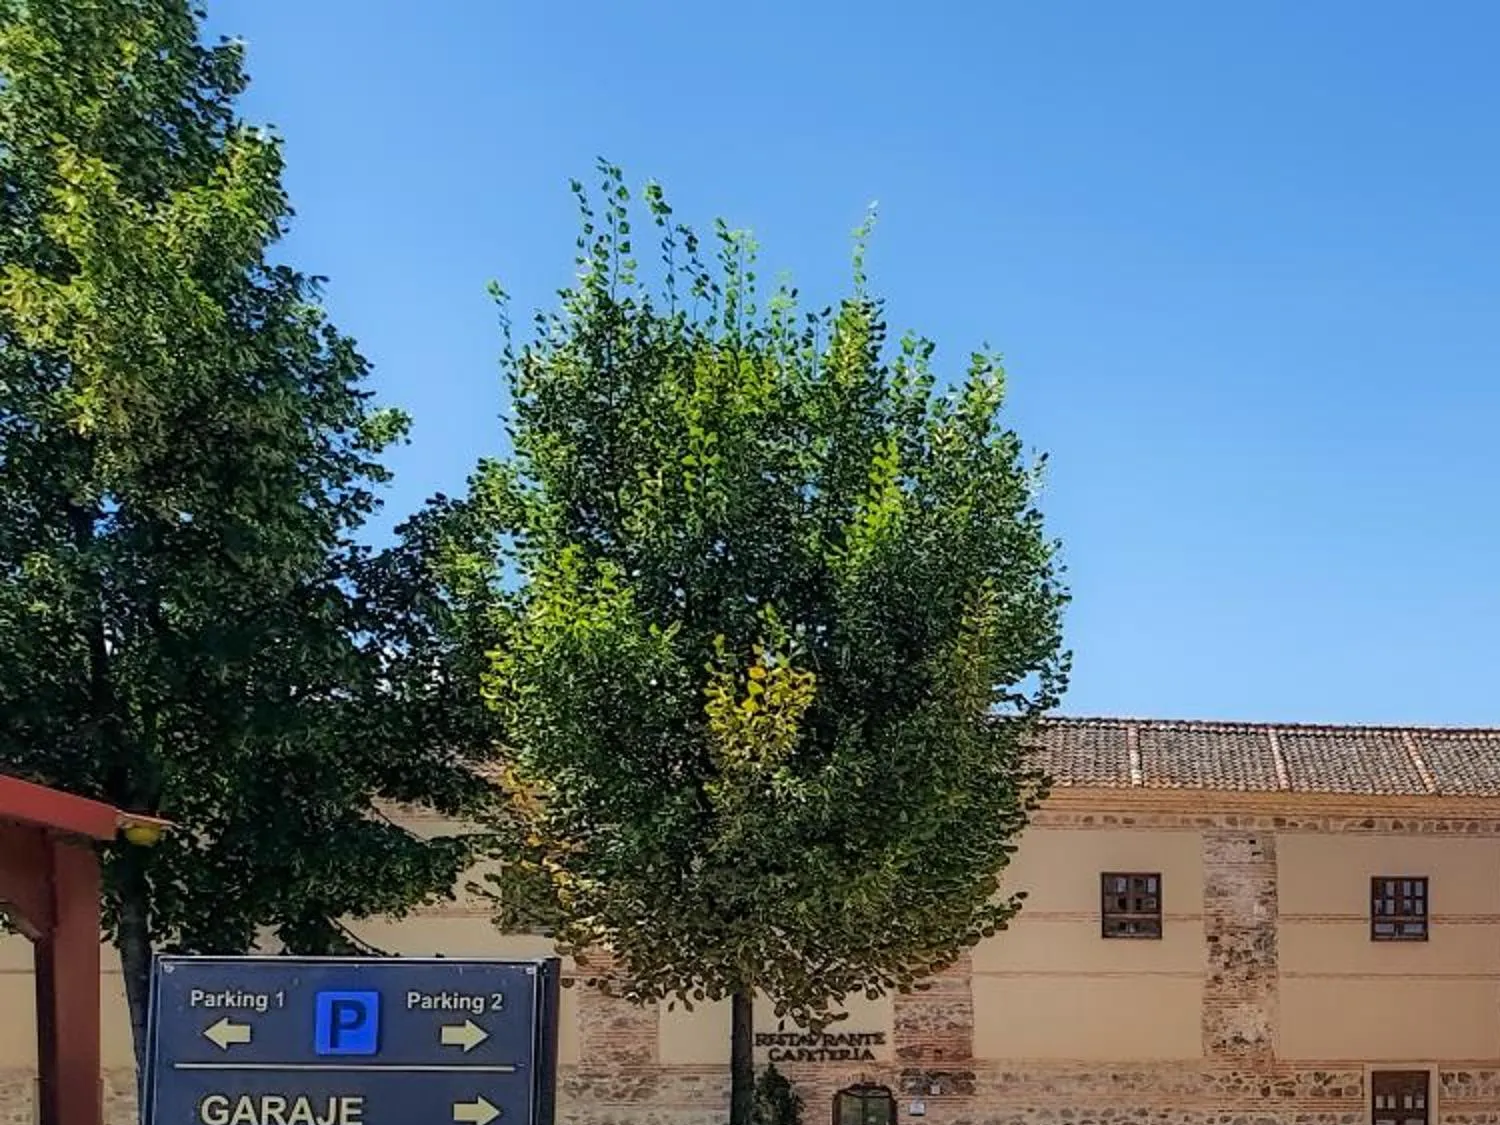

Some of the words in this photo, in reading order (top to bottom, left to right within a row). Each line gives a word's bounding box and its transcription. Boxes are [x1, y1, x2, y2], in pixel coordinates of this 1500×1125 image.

[190, 989, 269, 1012] Parking
[275, 991, 285, 1008] 1
[406, 991, 485, 1014] Parking
[490, 992, 503, 1010] 2
[329, 999, 367, 1049] P
